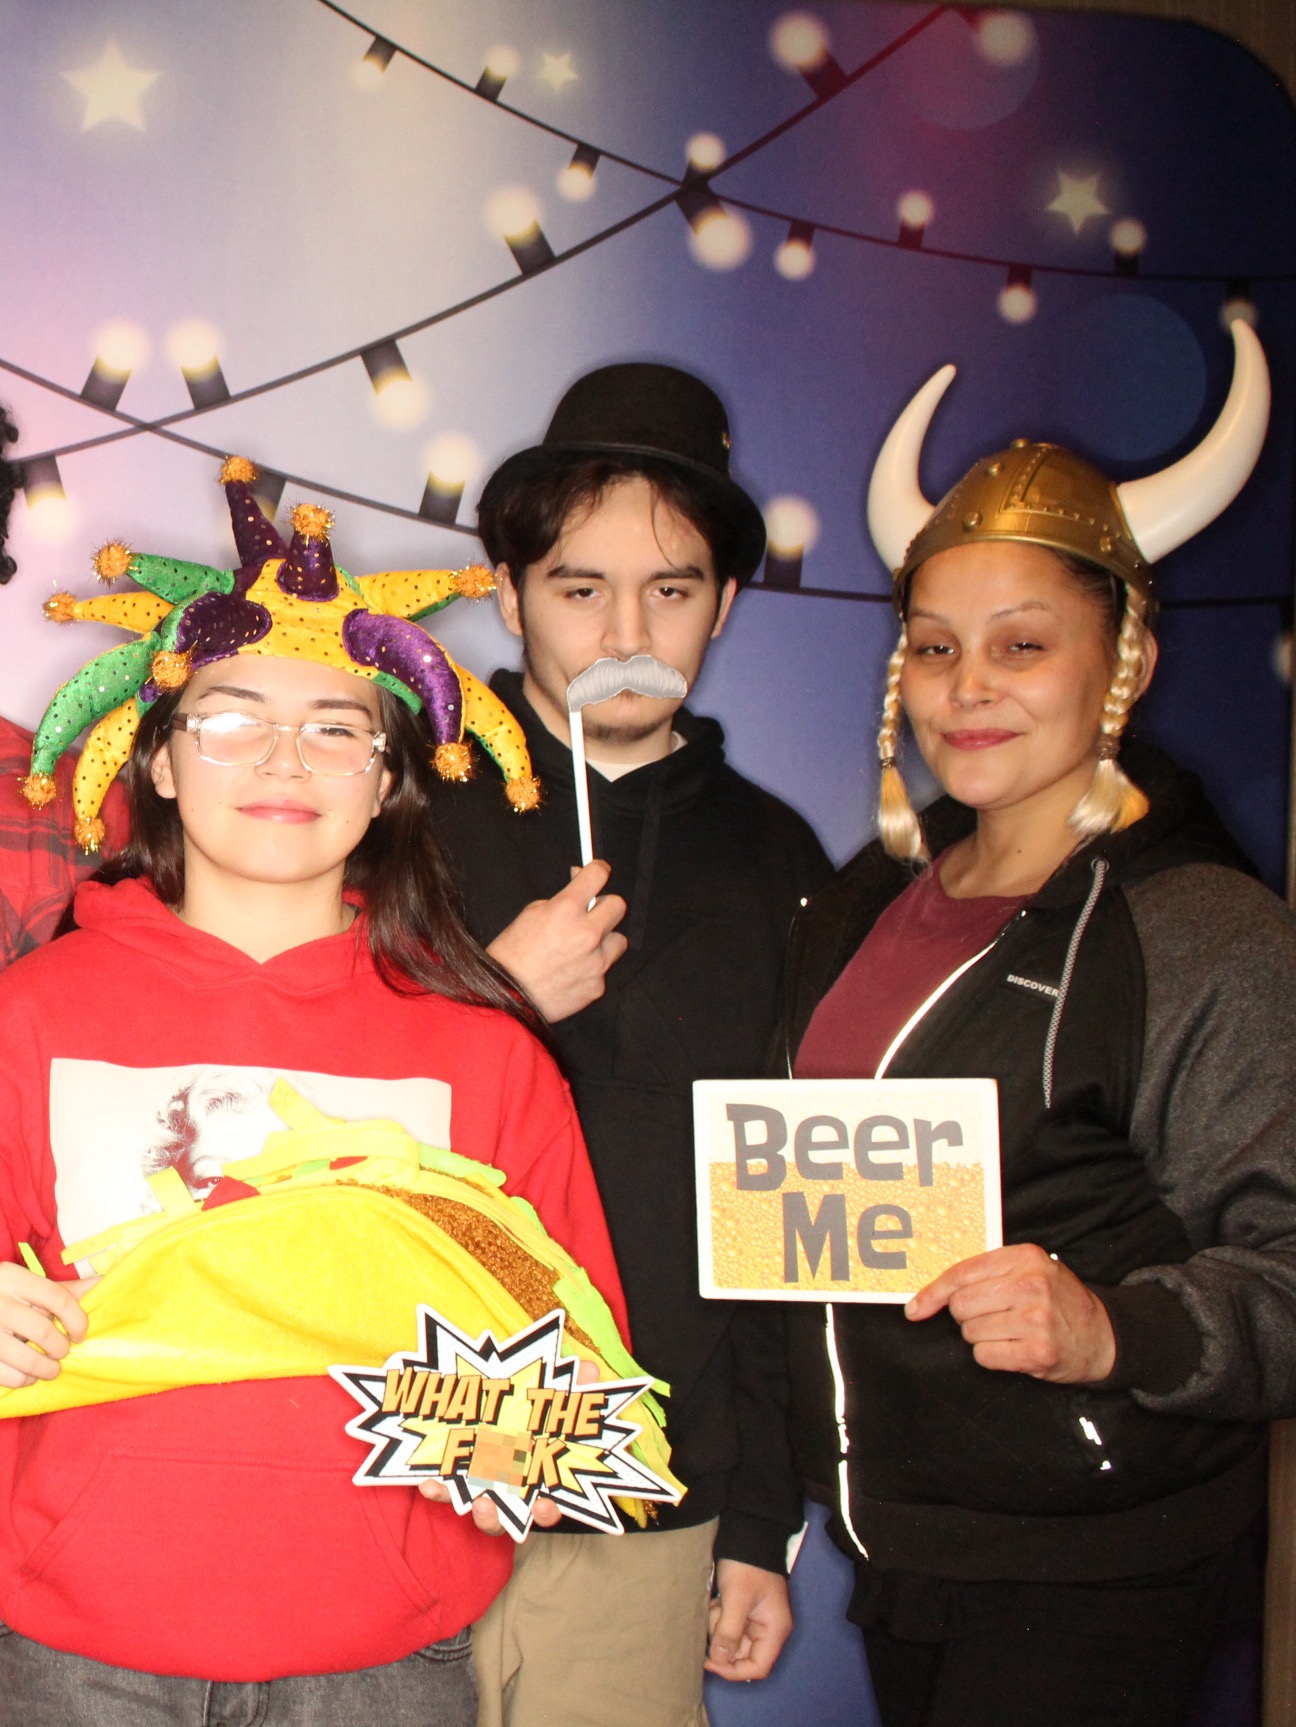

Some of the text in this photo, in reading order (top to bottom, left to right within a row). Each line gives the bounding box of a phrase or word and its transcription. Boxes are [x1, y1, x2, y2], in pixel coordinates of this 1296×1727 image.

[725, 1102, 964, 1191] Beer
[782, 1191, 913, 1283] Me
[382, 1367, 607, 1438] WHAT THE
[439, 1428, 569, 1490] FK
